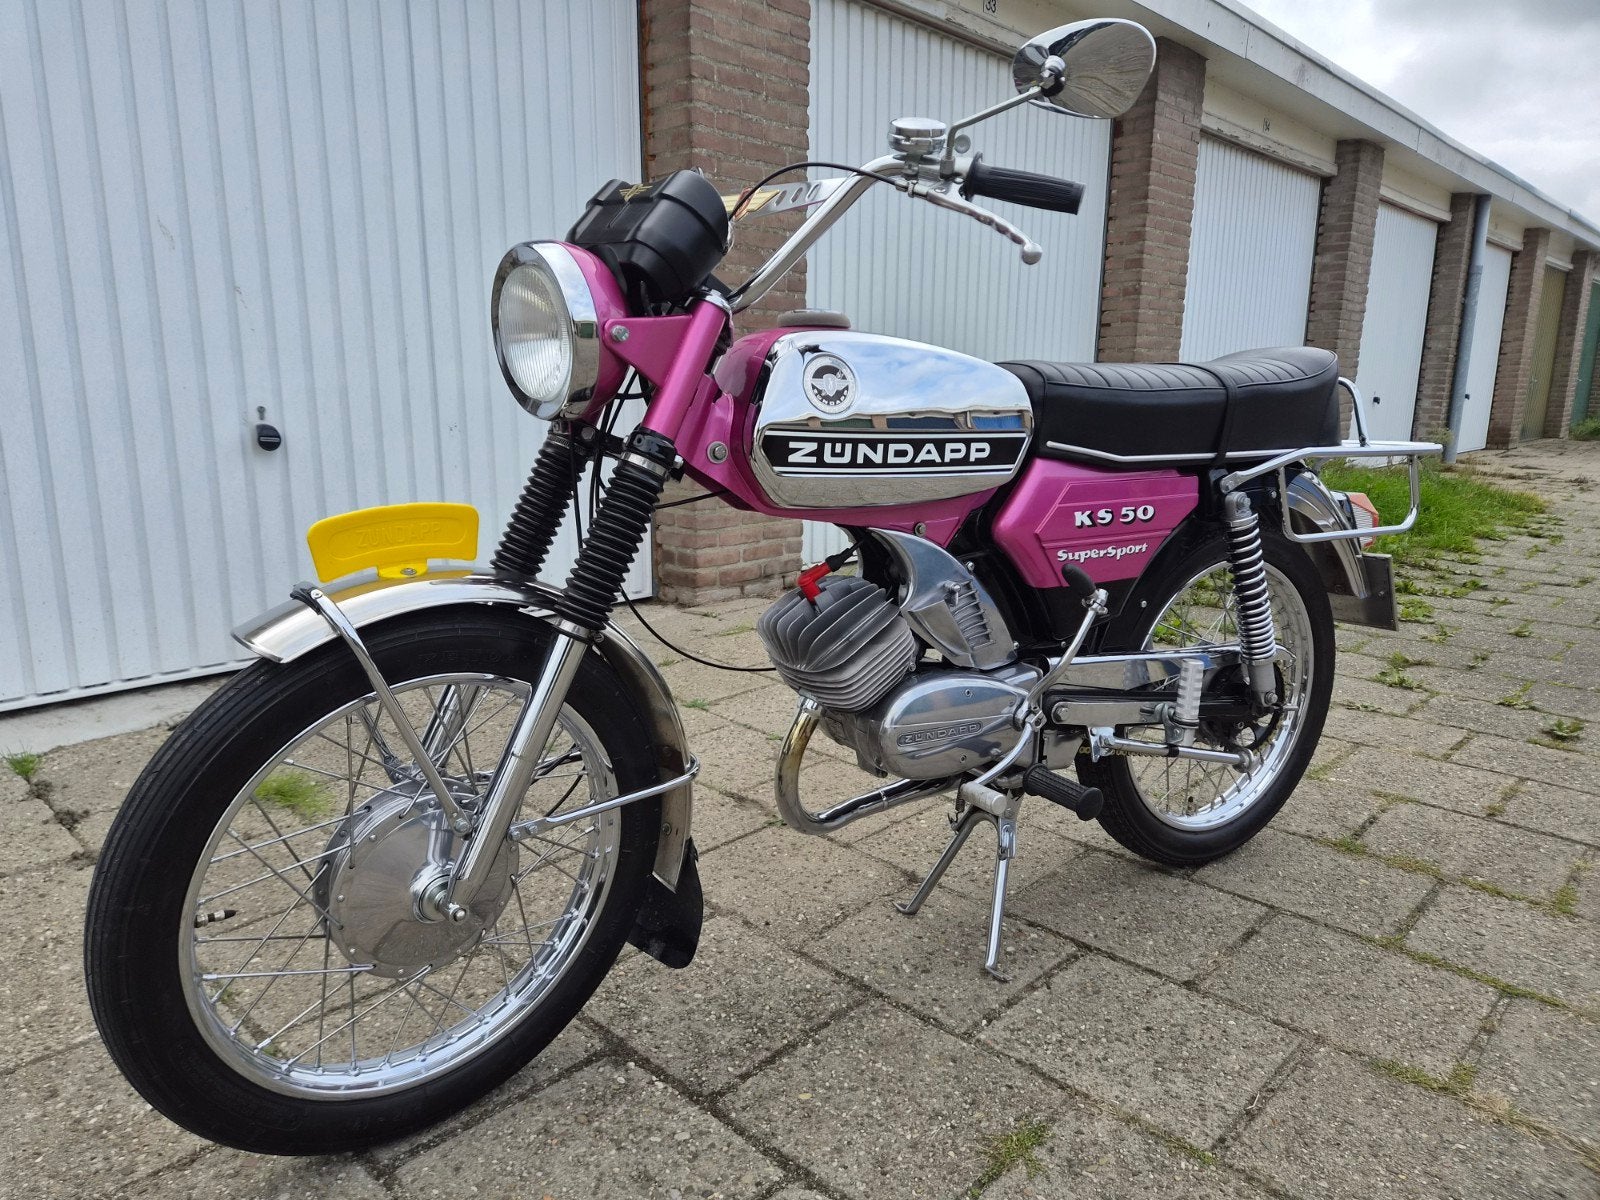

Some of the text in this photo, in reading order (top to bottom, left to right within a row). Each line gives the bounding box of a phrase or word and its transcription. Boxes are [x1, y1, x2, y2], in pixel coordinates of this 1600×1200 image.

[787, 441, 991, 464] ZÜNDAPP
[1074, 505, 1155, 528] KS 50
[1057, 543, 1149, 564] SuperSport
